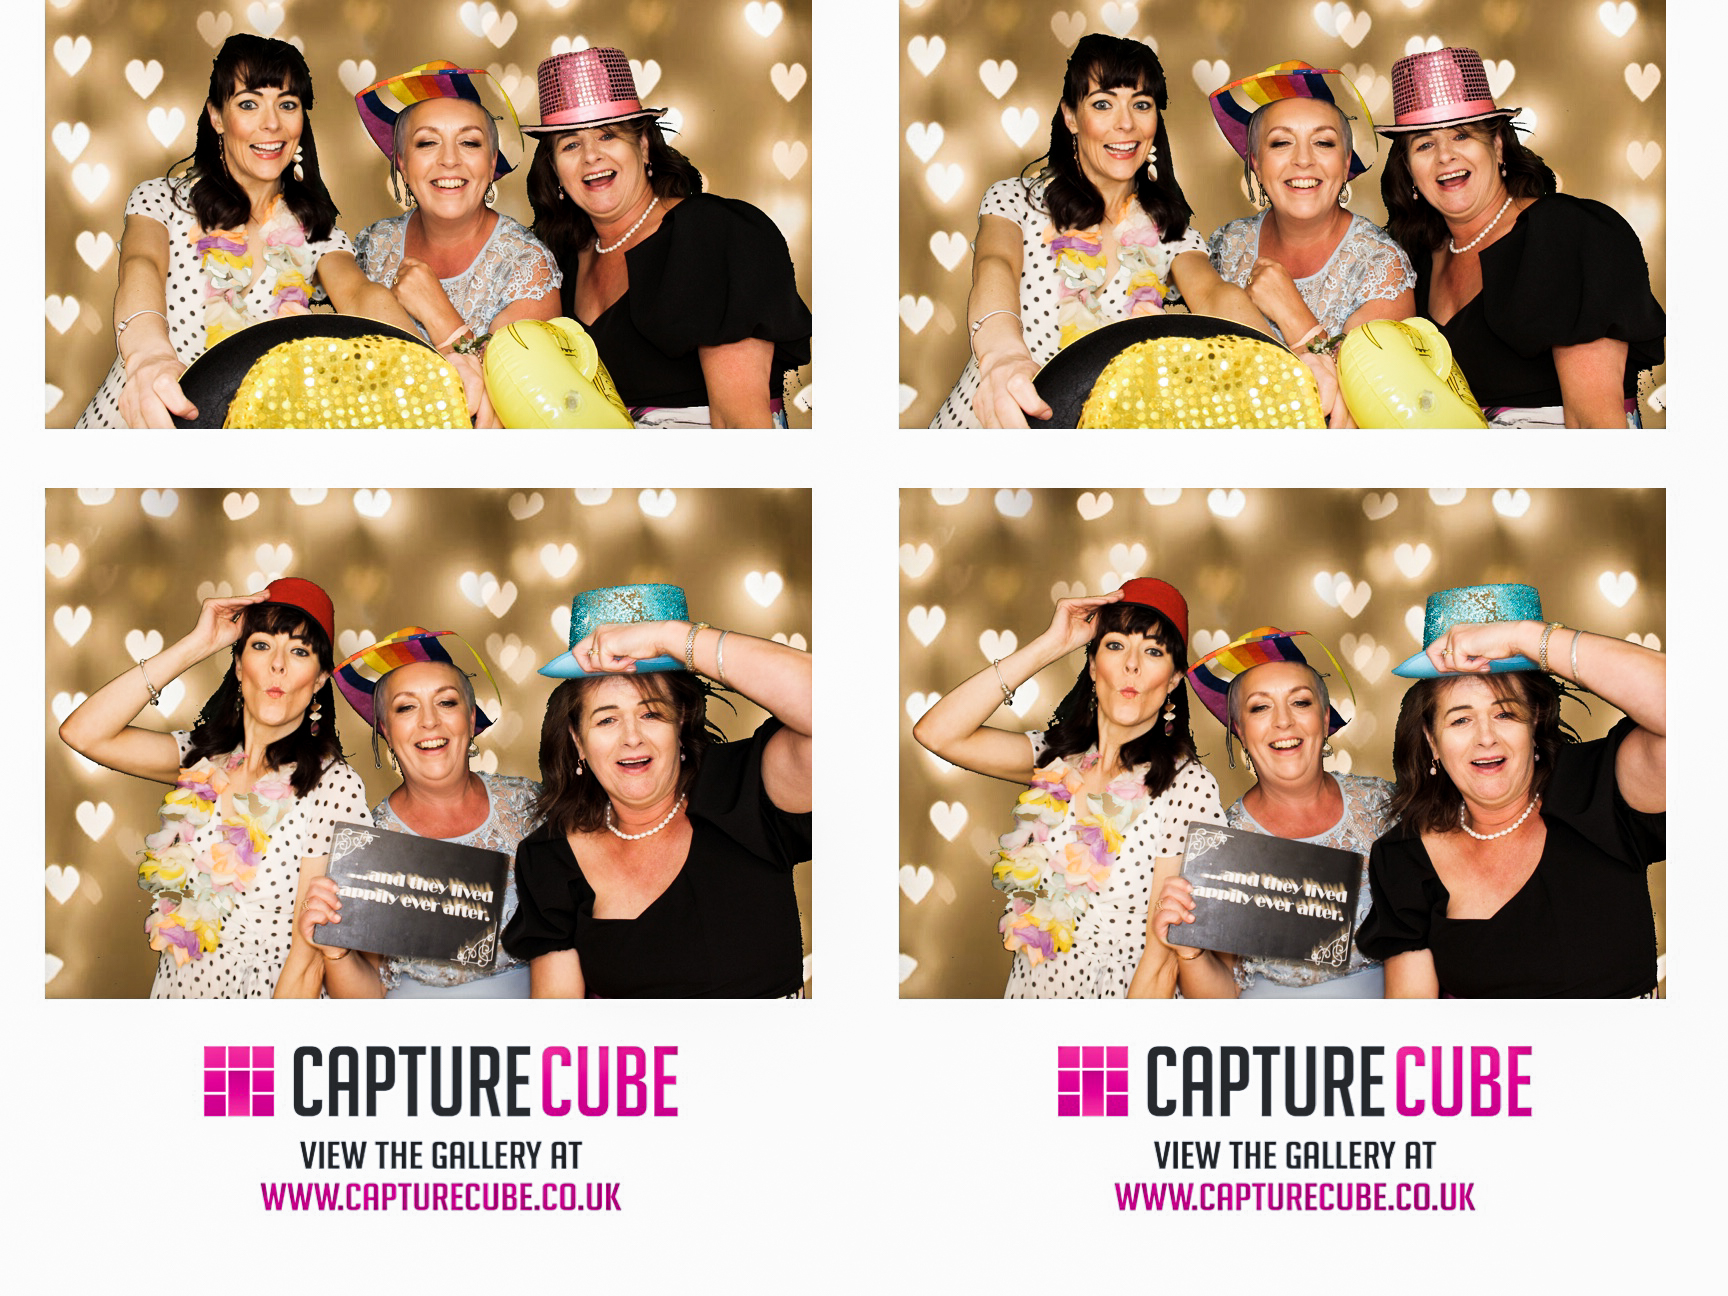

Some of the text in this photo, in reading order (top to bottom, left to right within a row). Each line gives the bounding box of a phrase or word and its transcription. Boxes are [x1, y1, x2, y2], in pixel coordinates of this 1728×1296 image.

[338, 885, 491, 922] appily ever after.
[407, 874, 449, 894] they
[450, 880, 494, 903] lived
[1192, 885, 1345, 922] appily ever after.
[1261, 874, 1303, 894] they
[1304, 880, 1348, 903] lived
